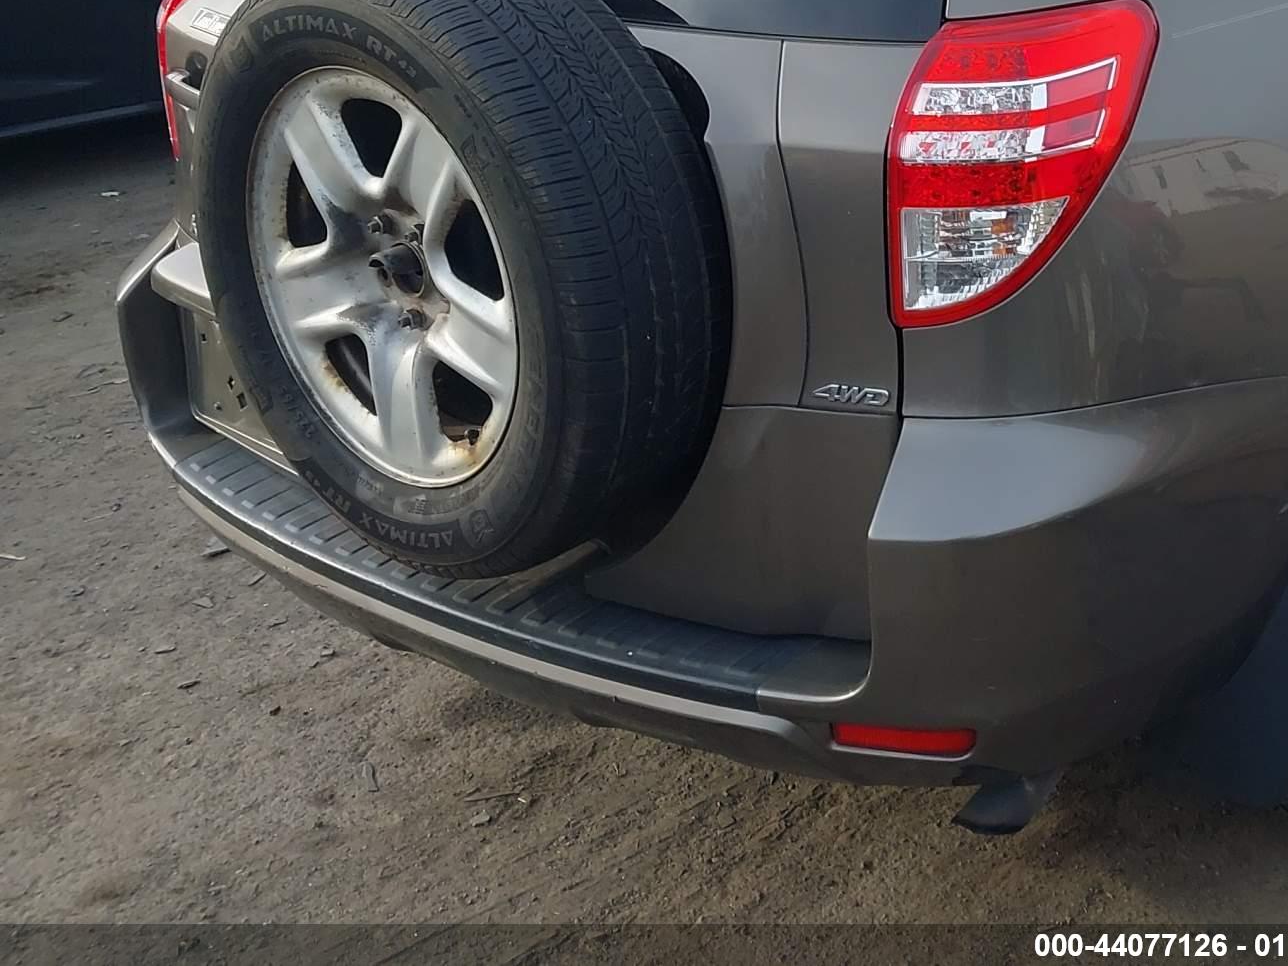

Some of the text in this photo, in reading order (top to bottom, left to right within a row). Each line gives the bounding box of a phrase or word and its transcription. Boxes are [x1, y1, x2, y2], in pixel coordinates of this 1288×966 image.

[261, 13, 358, 42] ALTIMAX
[812, 383, 889, 407] 4WD
[358, 511, 454, 549] ALTIMAX
